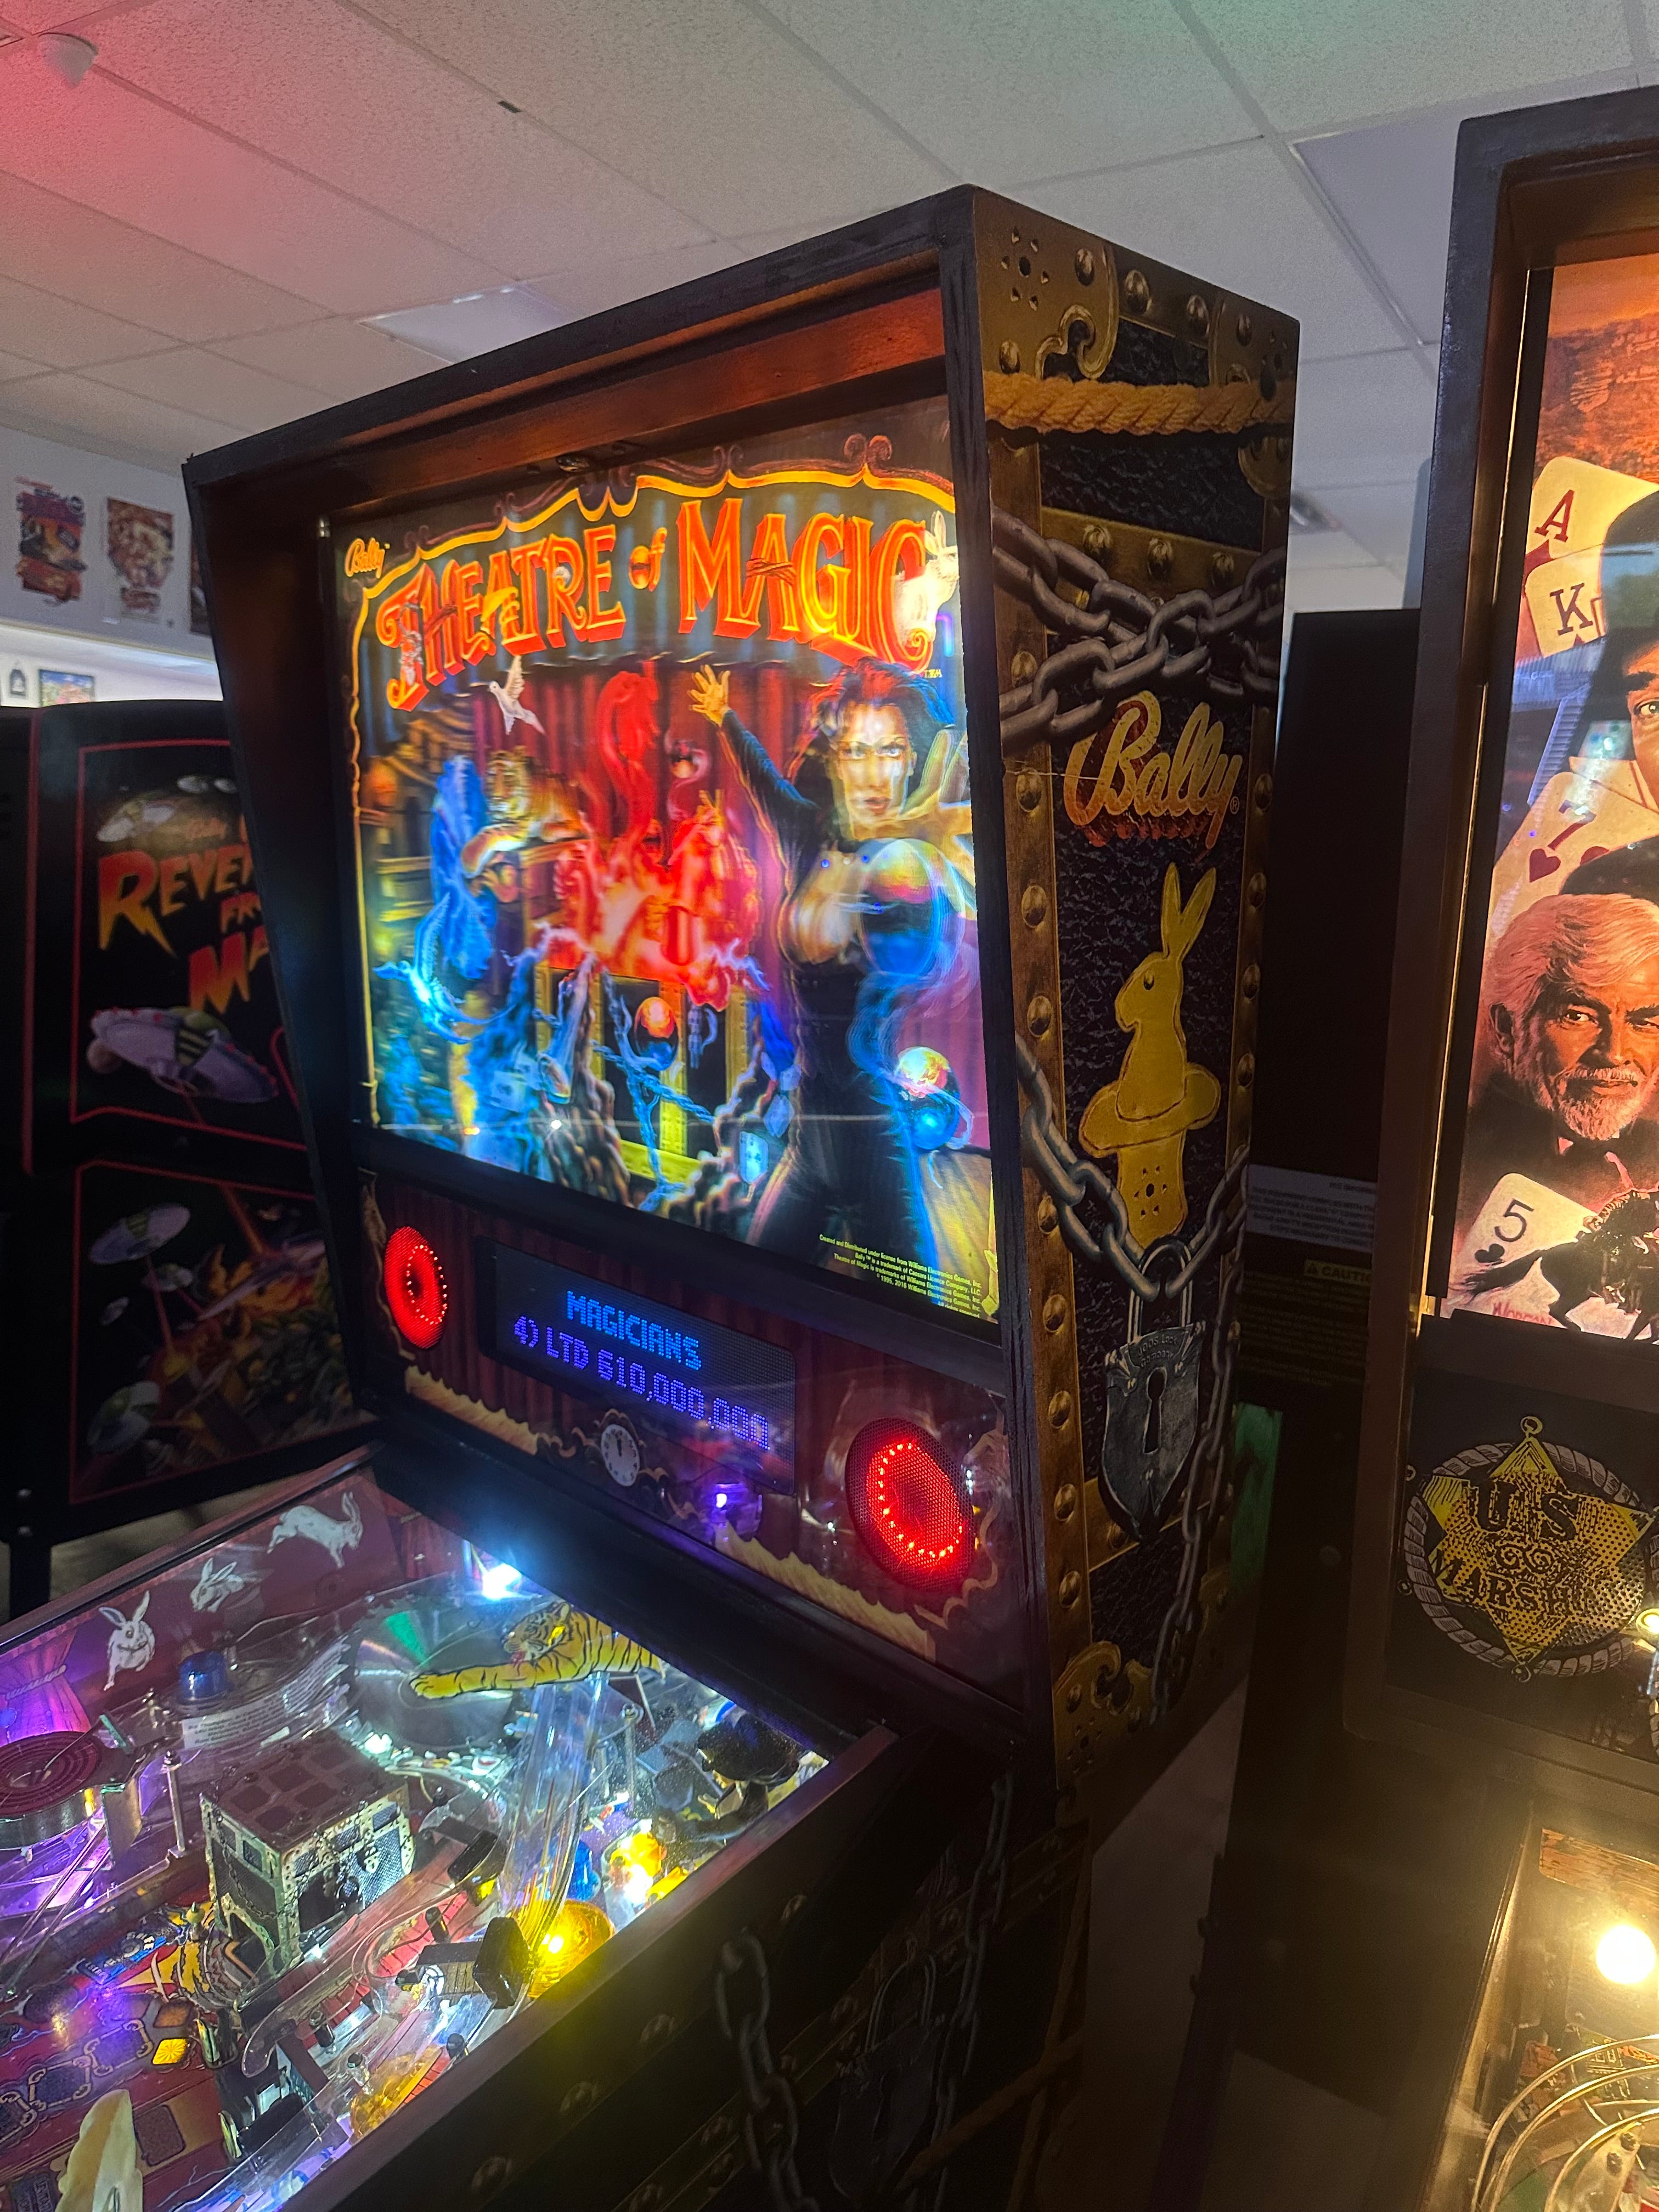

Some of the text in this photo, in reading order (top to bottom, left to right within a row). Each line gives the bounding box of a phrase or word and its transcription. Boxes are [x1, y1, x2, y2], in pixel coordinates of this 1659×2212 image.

[1534, 489, 1575, 543] A
[345, 537, 386, 579] Bally
[376, 498, 935, 712] THEATRE of MAGIC
[1550, 583, 1593, 636] K
[1063, 690, 1243, 849] Bally
[1494, 1198, 1534, 1243] 5
[906, 1276, 925, 1286] Williams
[907, 1283, 926, 1295] Williams
[908, 1260, 927, 1271] Williams
[928, 1266, 952, 1279] Electronics
[567, 1290, 702, 1370] MAGICIANS
[514, 1316, 770, 1451] 4) LTD 610,000,000
